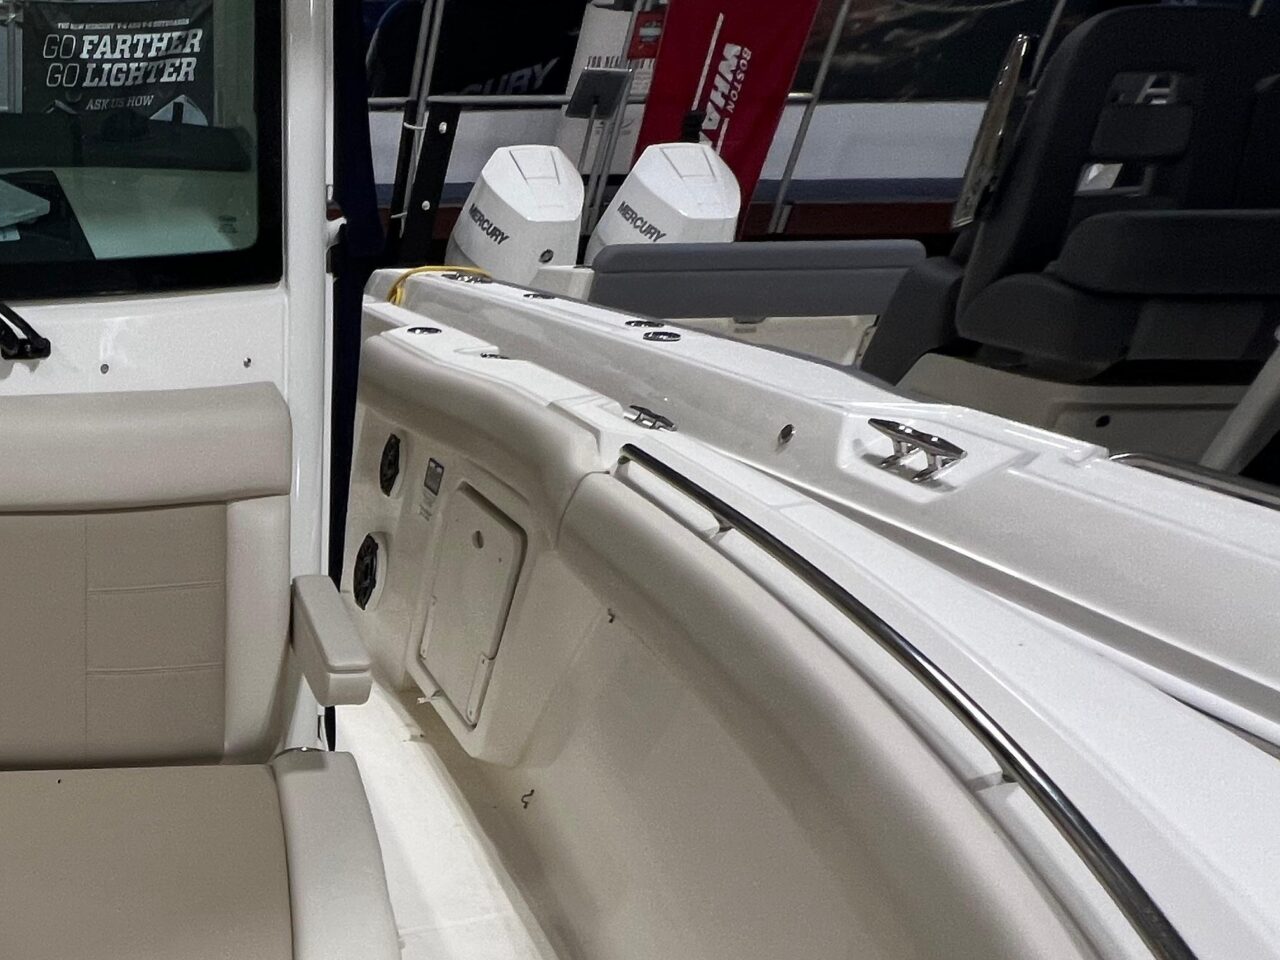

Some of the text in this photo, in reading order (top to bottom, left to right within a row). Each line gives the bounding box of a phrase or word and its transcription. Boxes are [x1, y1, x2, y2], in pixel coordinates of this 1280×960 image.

[43, 28, 203, 59] GO FARTHER
[46, 57, 197, 88] GO LIGHTER
[726, 47, 752, 113] BOSTON
[85, 98, 110, 111] ASK
[126, 95, 154, 107] HOW
[699, 43, 741, 147] WHA
[469, 203, 510, 245] MERCURY
[618, 201, 666, 243] MERCURY
